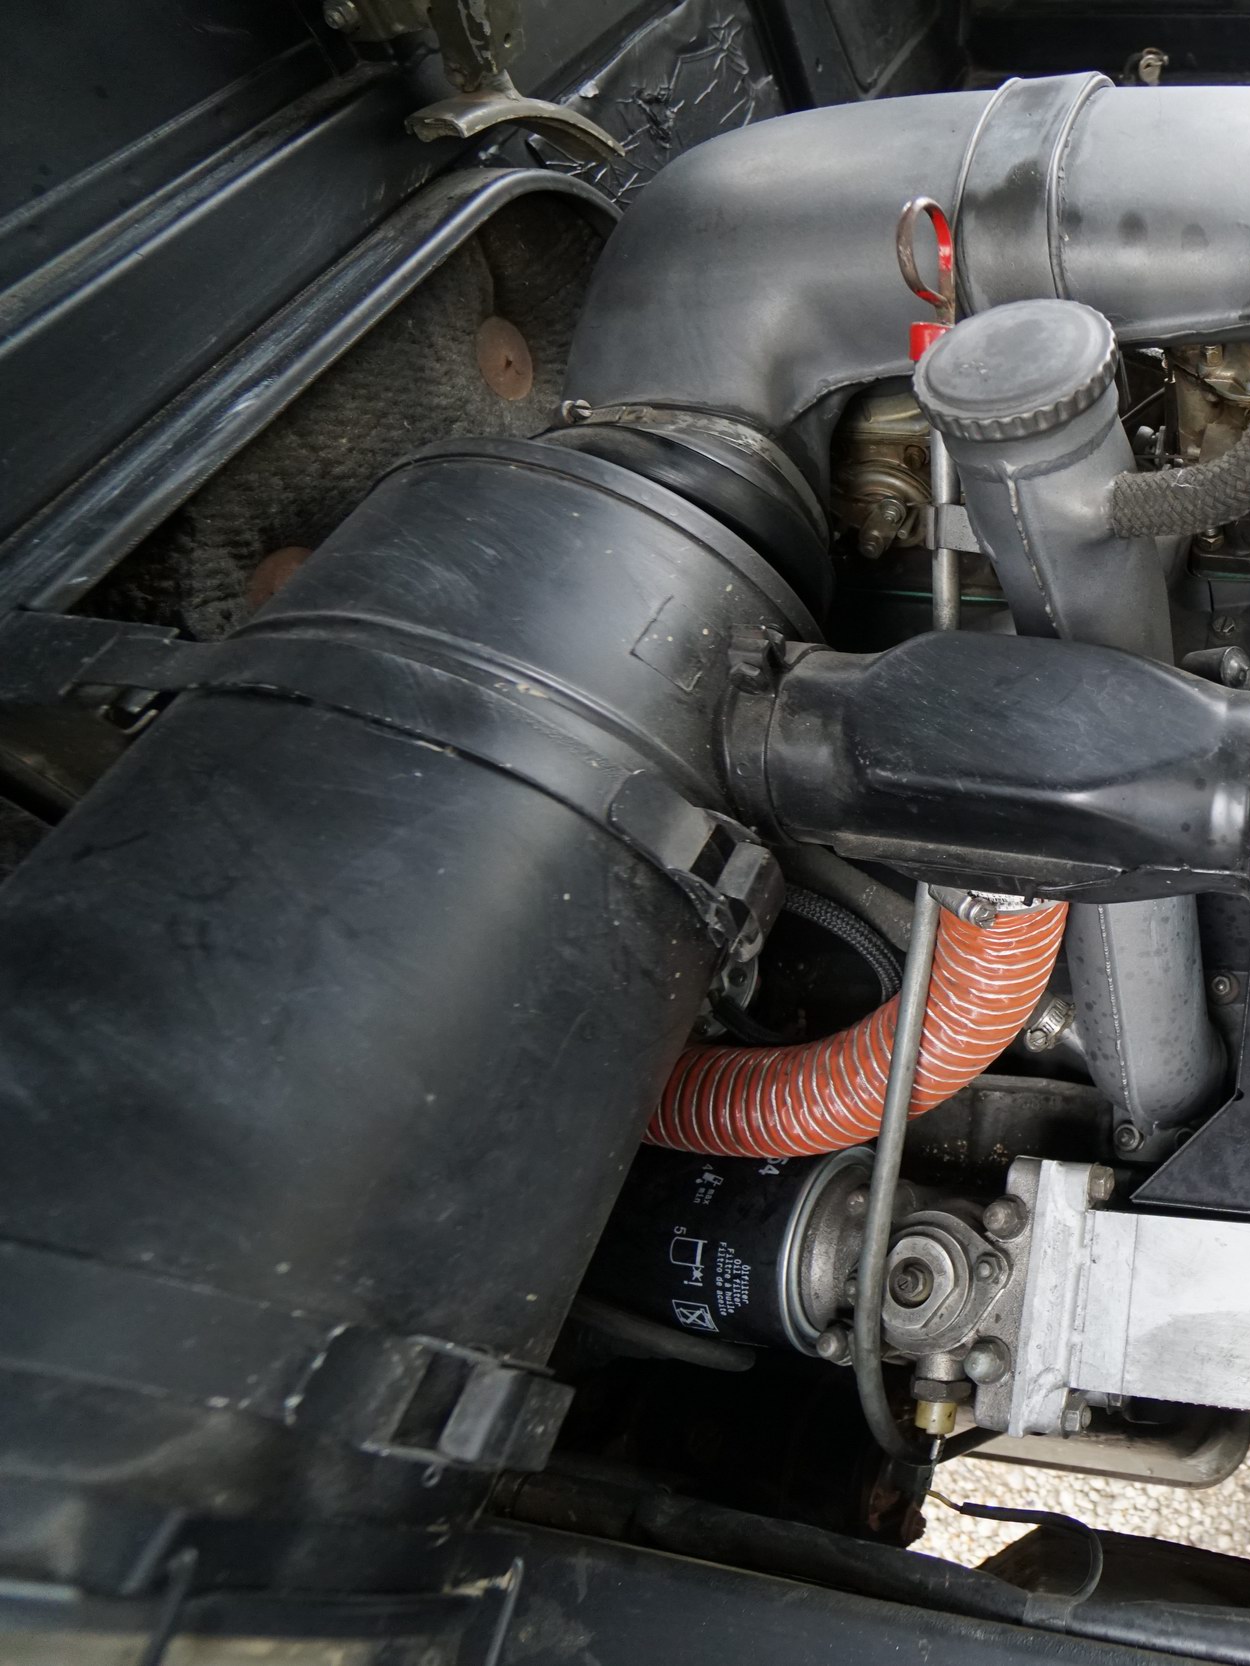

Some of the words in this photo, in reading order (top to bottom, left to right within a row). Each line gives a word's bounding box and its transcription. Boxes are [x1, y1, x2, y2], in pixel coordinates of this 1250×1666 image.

[673, 1225, 687, 1235] 5
[716, 1241, 727, 1273] Filtro
[724, 1248, 735, 1279] Filtre
[733, 1259, 742, 1274] Oil
[715, 1276, 724, 1287] de
[733, 1279, 742, 1307] filter
[716, 1290, 727, 1316] aceite
[724, 1291, 735, 1314] huile
